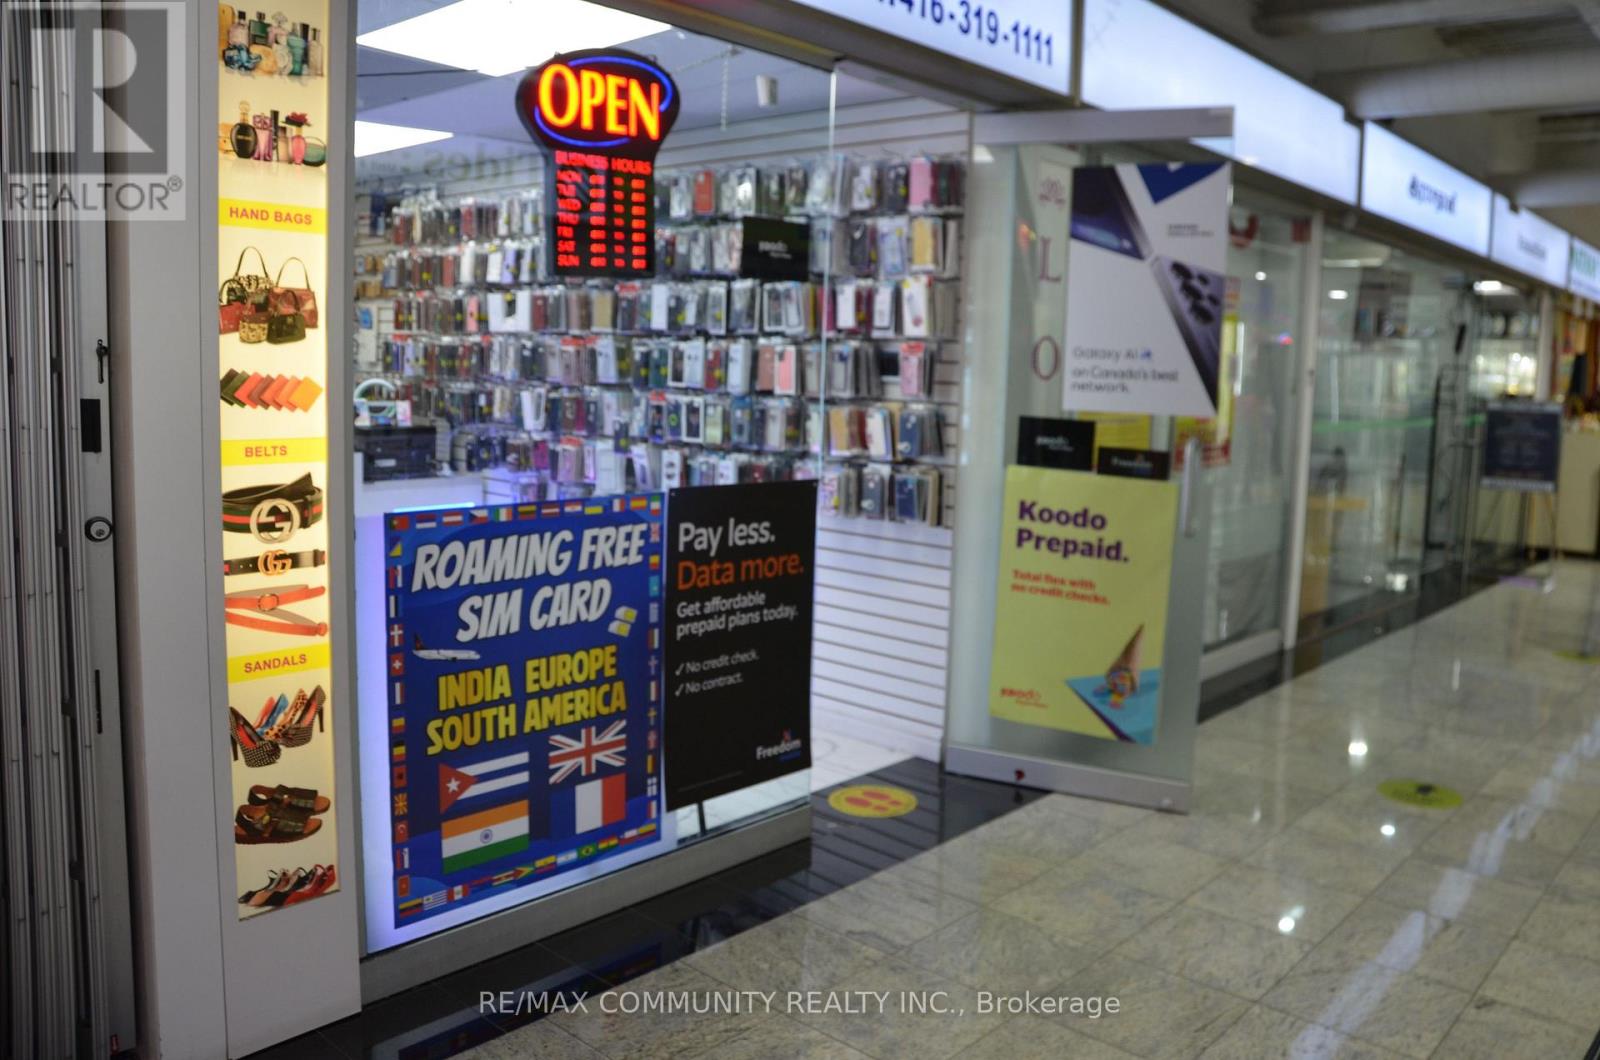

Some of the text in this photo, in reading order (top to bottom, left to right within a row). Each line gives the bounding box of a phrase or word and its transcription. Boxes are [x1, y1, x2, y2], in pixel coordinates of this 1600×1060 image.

[538, 64, 660, 140] OPEN
[611, 157, 652, 175] HOURS
[229, 206, 313, 225] HAND BAGS
[245, 445, 288, 458] BELTS
[1018, 500, 1107, 530] Koodo
[678, 517, 775, 557] Pay less.
[1016, 528, 1130, 563] Prepaid.
[411, 523, 648, 593] ROAMING FREE
[678, 554, 804, 591] Data more.
[456, 578, 612, 643] SIM CARD
[676, 591, 766, 618] Get affordable
[676, 604, 799, 641] prepaid plans today.
[244, 654, 307, 674] SANDALS
[438, 644, 617, 712] INDIA EUROPE
[685, 661, 701, 673] No
[702, 654, 729, 671] credit
[685, 682, 701, 694] No
[425, 680, 627, 756] SOUTH AMERICA
[756, 739, 802, 760] Freedom
